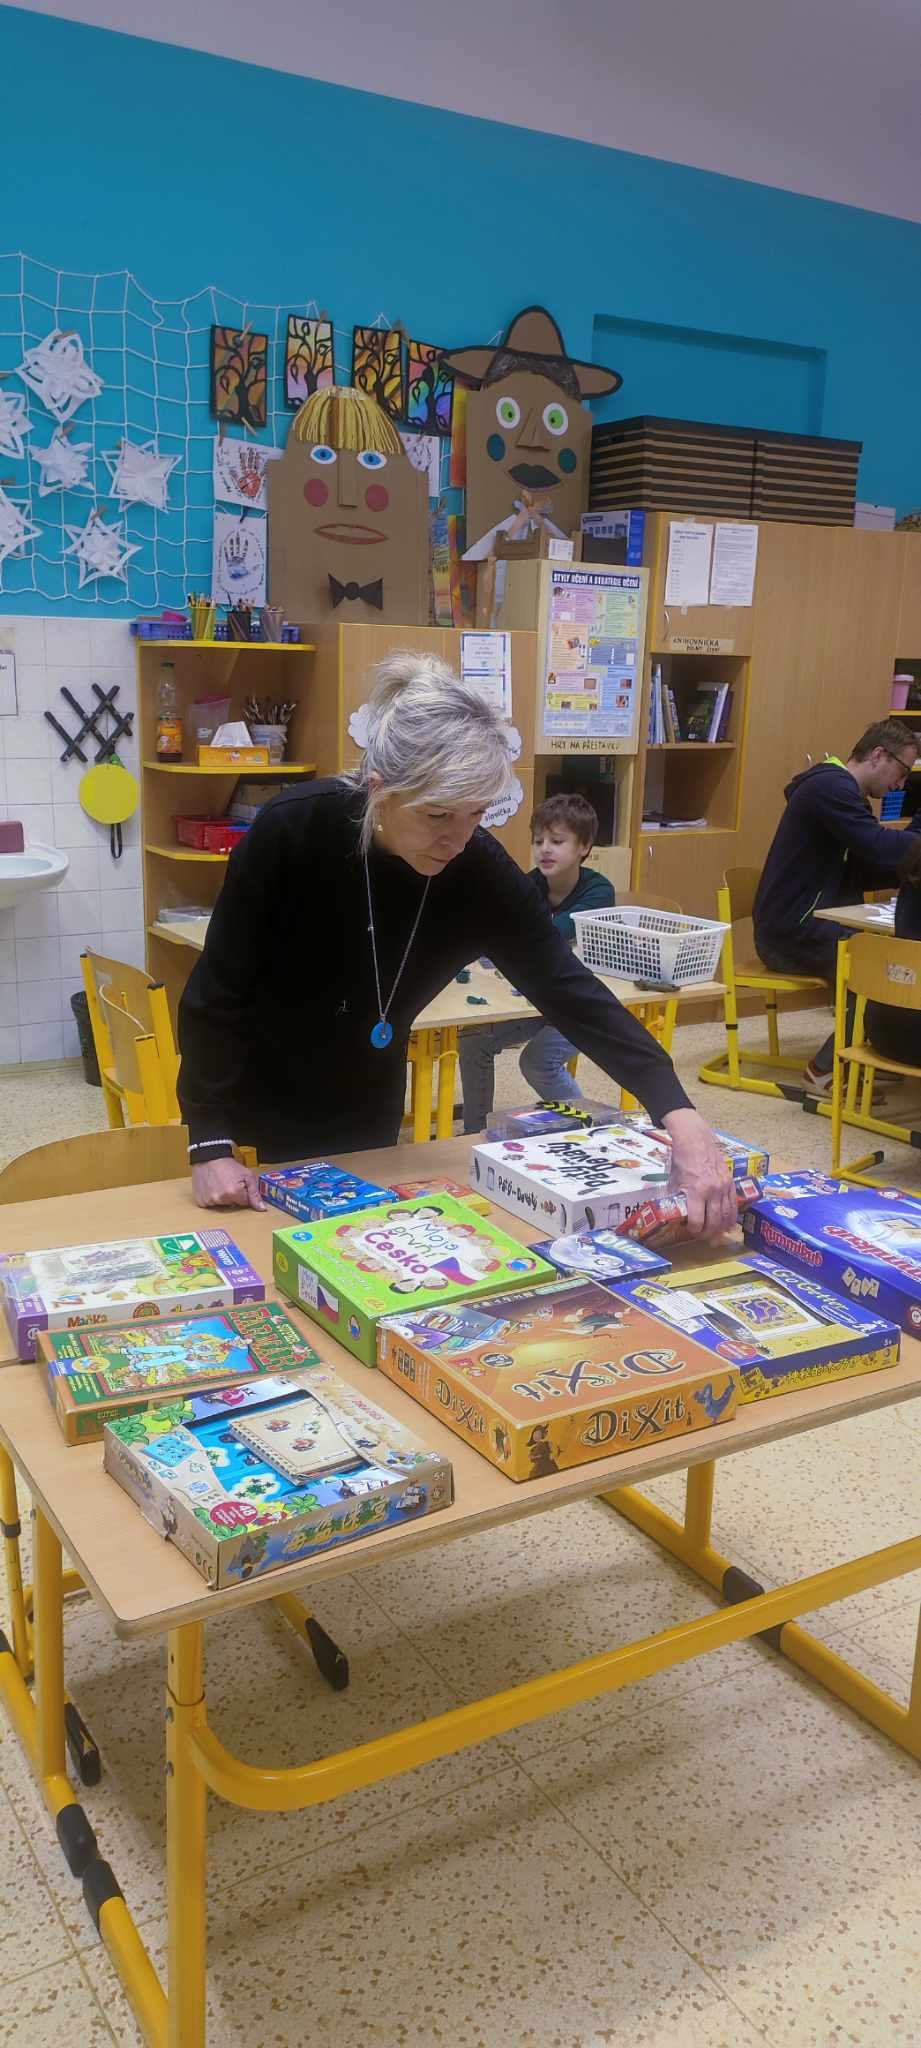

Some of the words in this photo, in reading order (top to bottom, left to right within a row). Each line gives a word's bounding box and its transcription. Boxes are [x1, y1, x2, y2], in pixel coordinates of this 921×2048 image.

[553, 573, 570, 582] STYLY
[571, 573, 587, 584] UČENÍ
[594, 575, 621, 586] STRATEGIE
[622, 576, 639, 588] UČENÍ
[570, 740, 580, 749] NA
[365, 1228, 429, 1274] Česko
[761, 1219, 823, 1267] Rummikub
